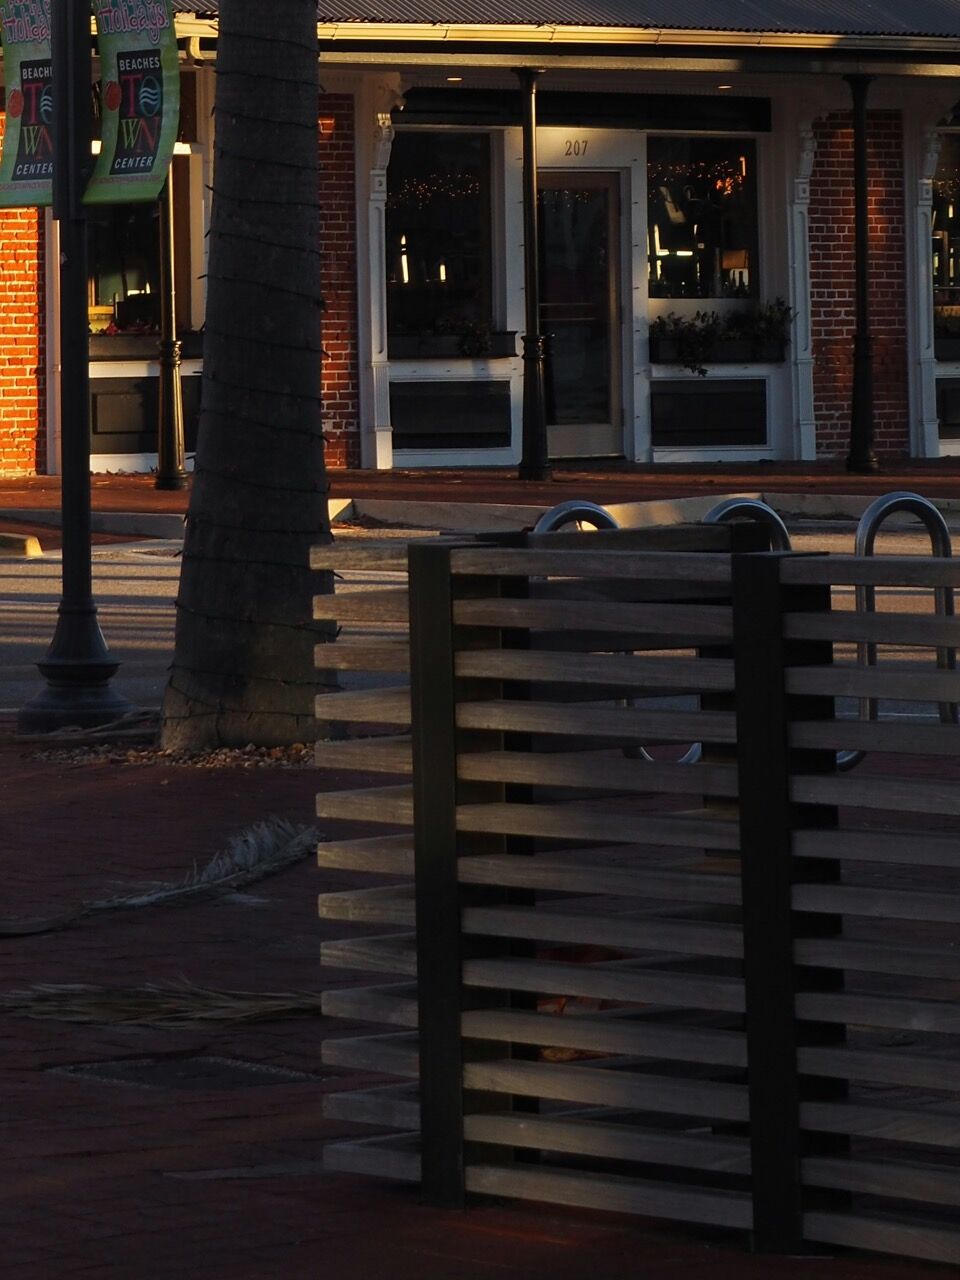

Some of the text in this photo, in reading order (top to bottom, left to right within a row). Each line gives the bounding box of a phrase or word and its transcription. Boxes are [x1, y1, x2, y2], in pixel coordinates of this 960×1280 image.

[0, 7, 51, 44] Holida
[119, 57, 160, 71] BEACHES
[22, 67, 53, 80] BEACH
[565, 140, 588, 156] 207
[114, 156, 153, 169] CENTER
